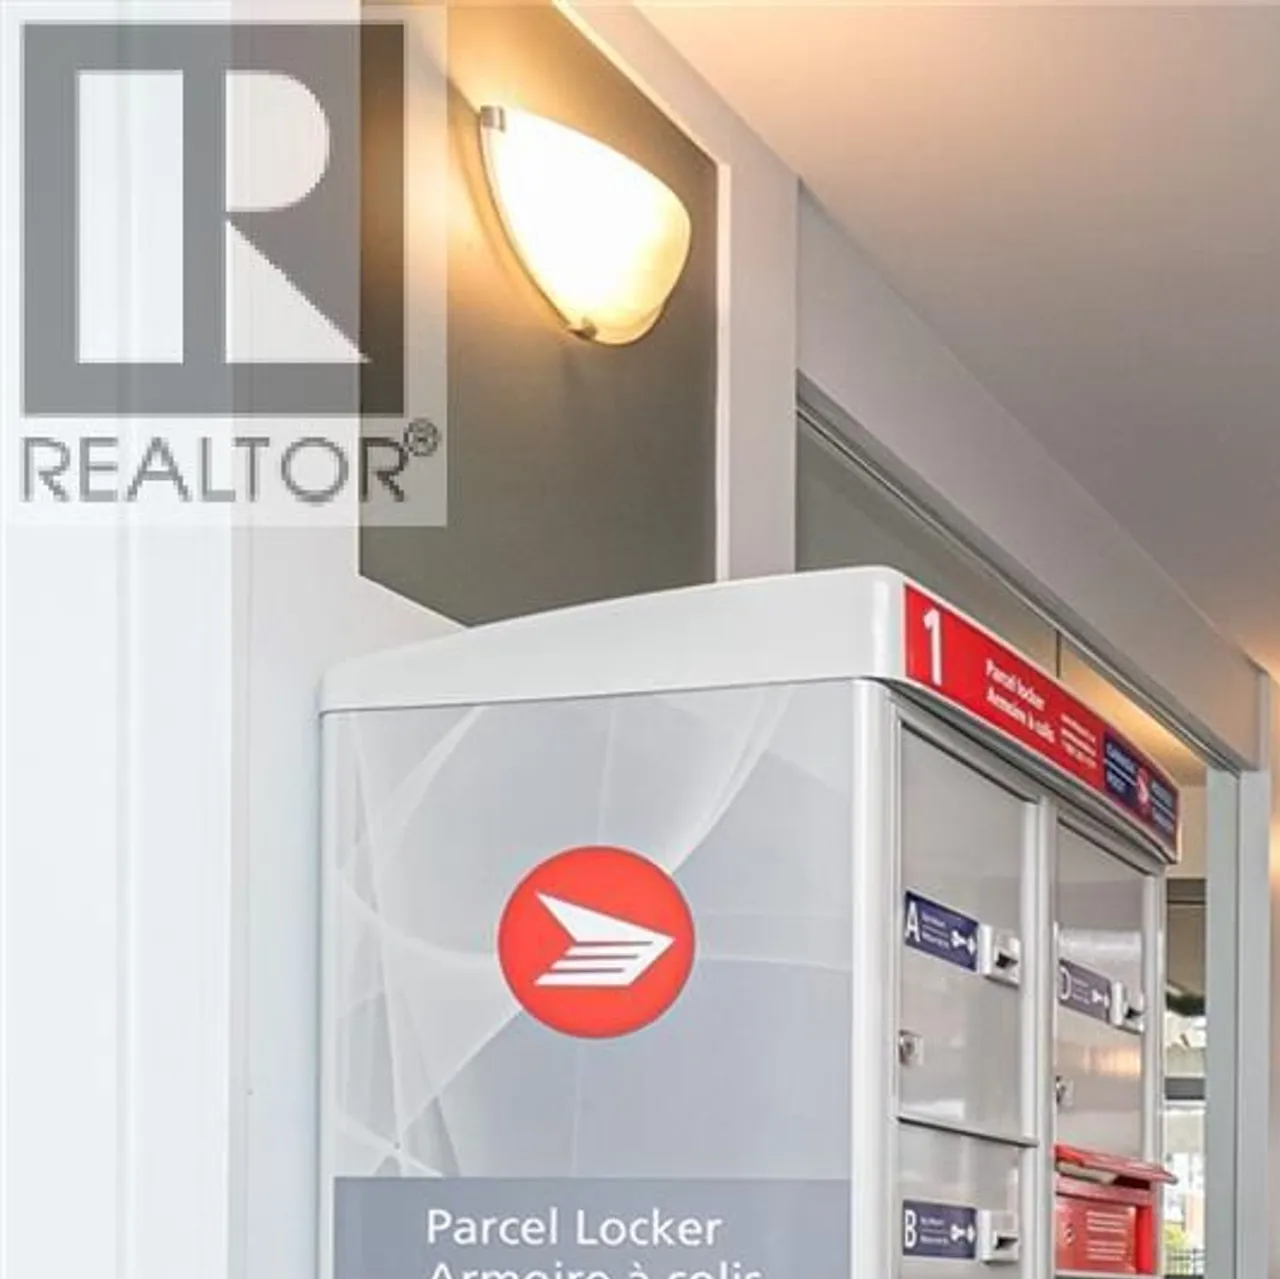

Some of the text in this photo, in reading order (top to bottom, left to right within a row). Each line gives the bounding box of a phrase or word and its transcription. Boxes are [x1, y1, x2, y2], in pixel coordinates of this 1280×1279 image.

[923, 607, 942, 686] 1
[905, 902, 921, 943] A
[427, 1207, 723, 1247] Parcel Locker
[904, 1210, 918, 1248] B
